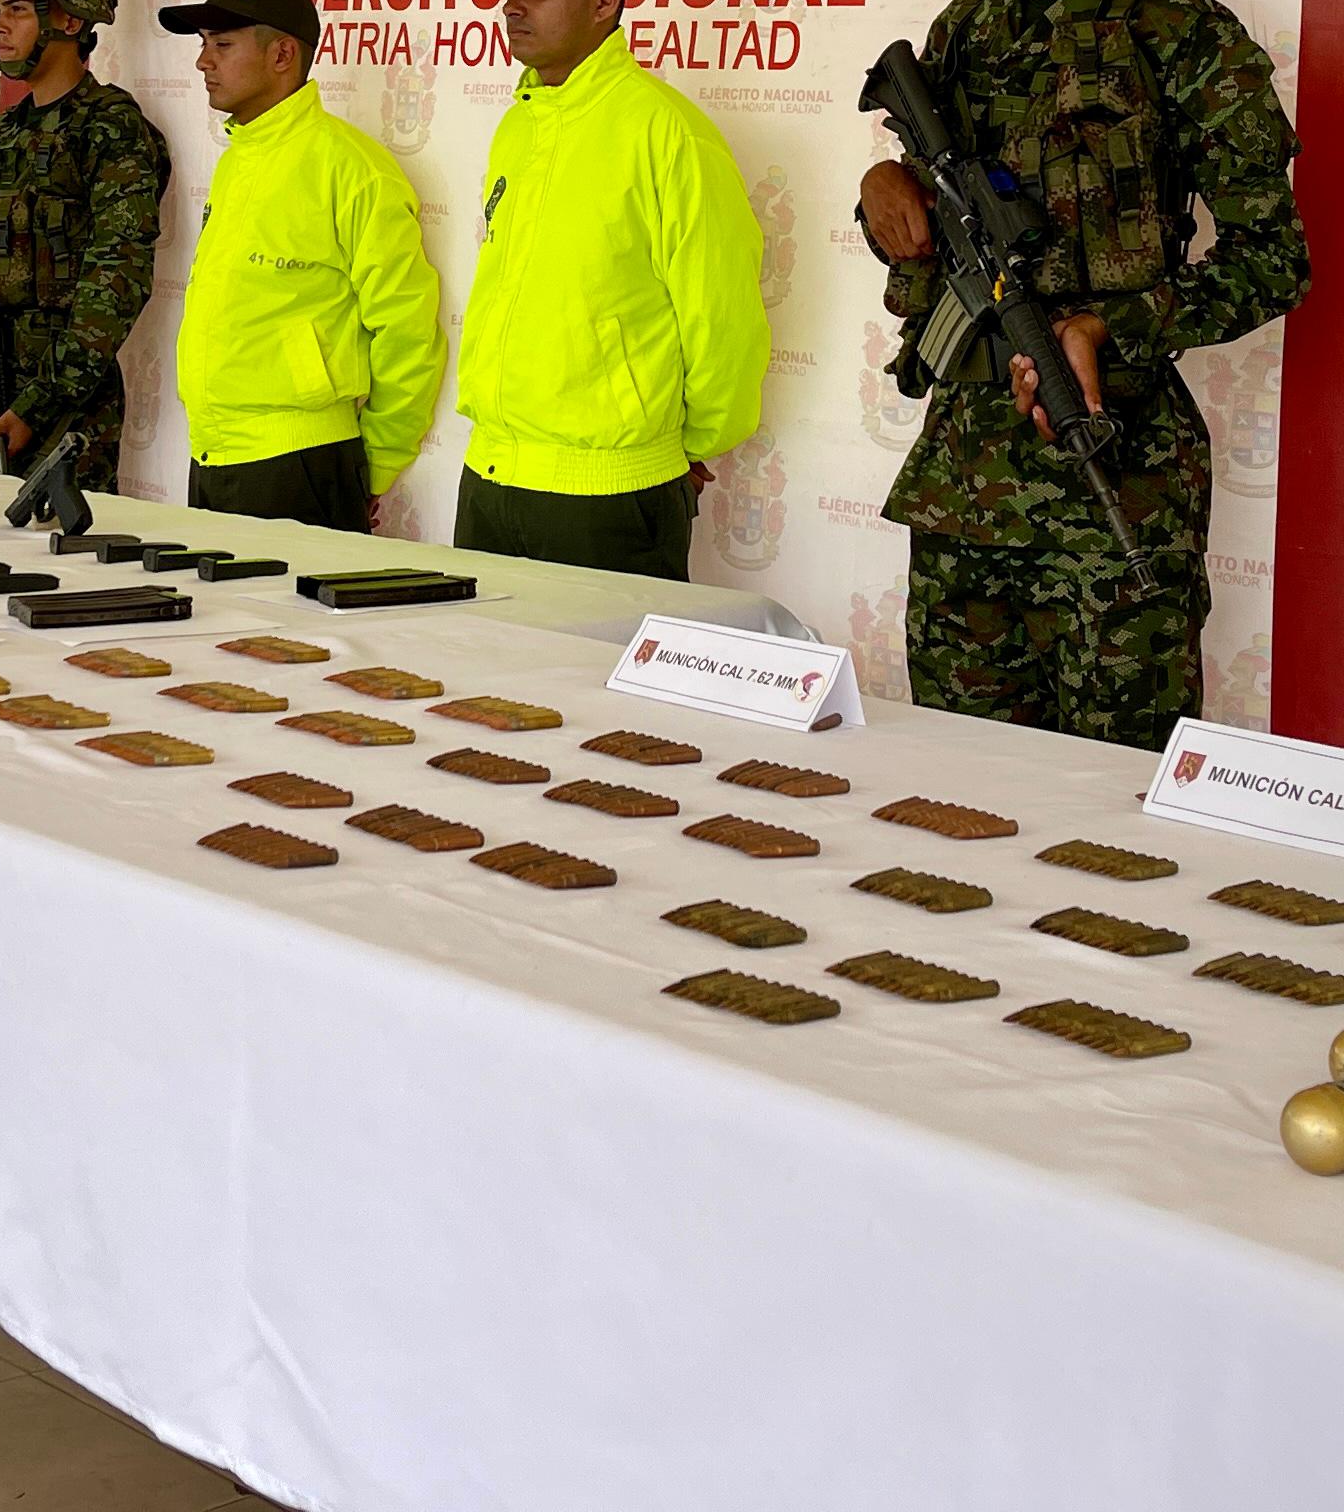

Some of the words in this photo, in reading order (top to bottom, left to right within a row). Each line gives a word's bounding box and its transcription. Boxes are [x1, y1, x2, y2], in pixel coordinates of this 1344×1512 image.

[314, 22, 413, 67] ATRIA
[433, 21, 513, 67] HON
[628, 20, 801, 70] EALTAD
[320, 80, 359, 93] ACIONAL
[699, 85, 760, 101] EJÉRCITO
[764, 88, 834, 103] NACIONAL
[742, 102, 776, 113] HONOR
[780, 103, 822, 115] LEALTAD
[770, 349, 817, 366] CIONAL
[768, 363, 807, 377] EALTAD
[1213, 572, 1261, 588] HONOR
[655, 649, 720, 674] MUNICIÓN
[719, 663, 744, 681] CAL
[746, 668, 775, 687] 7.62
[774, 674, 800, 691] MM
[1207, 765, 1305, 802] MUNICIÓN
